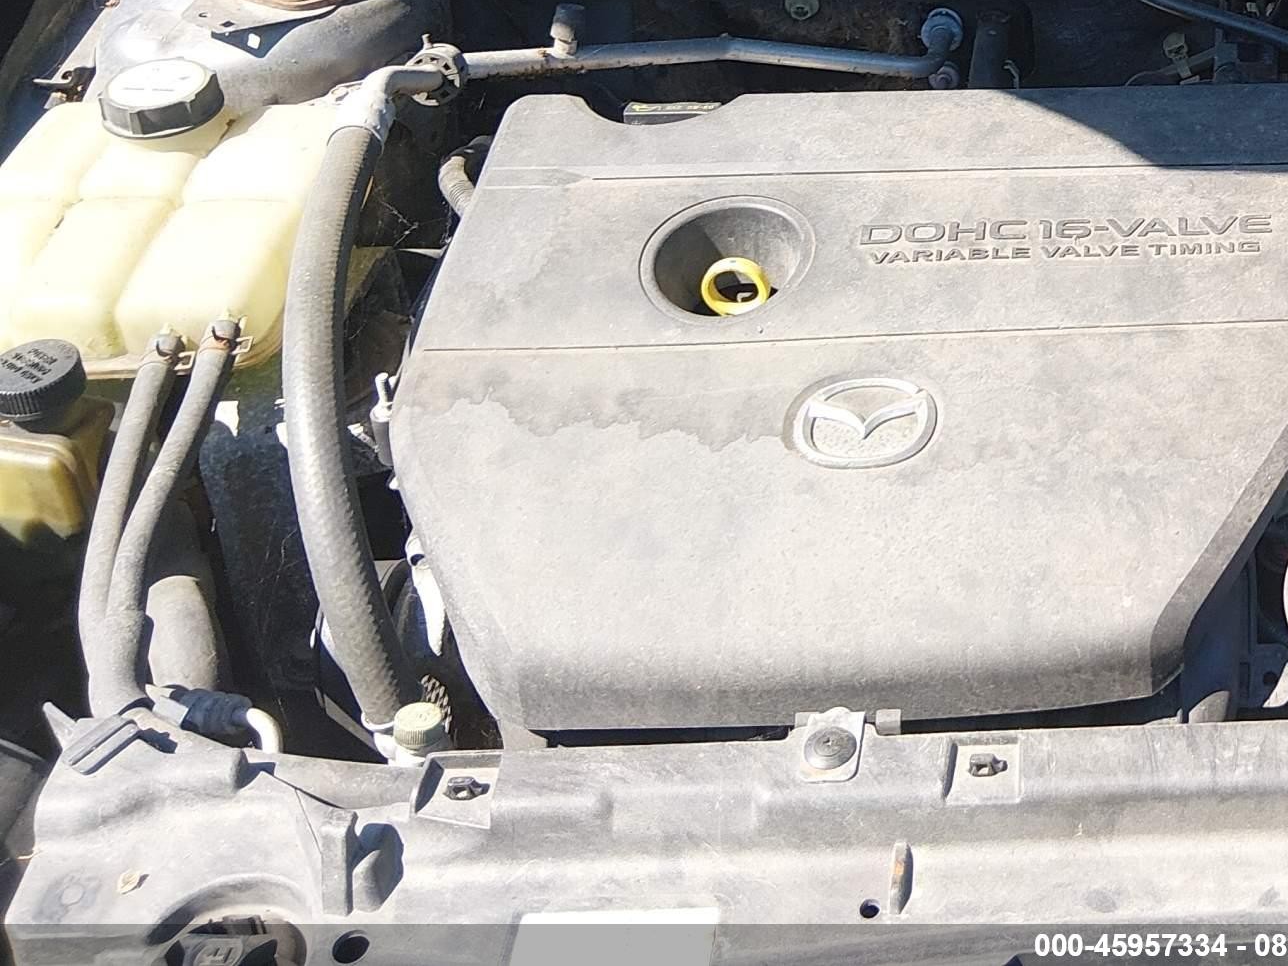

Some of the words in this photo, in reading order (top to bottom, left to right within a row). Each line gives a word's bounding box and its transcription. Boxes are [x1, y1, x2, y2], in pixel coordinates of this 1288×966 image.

[859, 219, 1028, 246] DOHC
[1039, 213, 1274, 240] 16-VALVE
[870, 246, 1032, 265] VARIABLE
[1041, 243, 1144, 259] VALVE
[1148, 240, 1262, 257] TIMING
